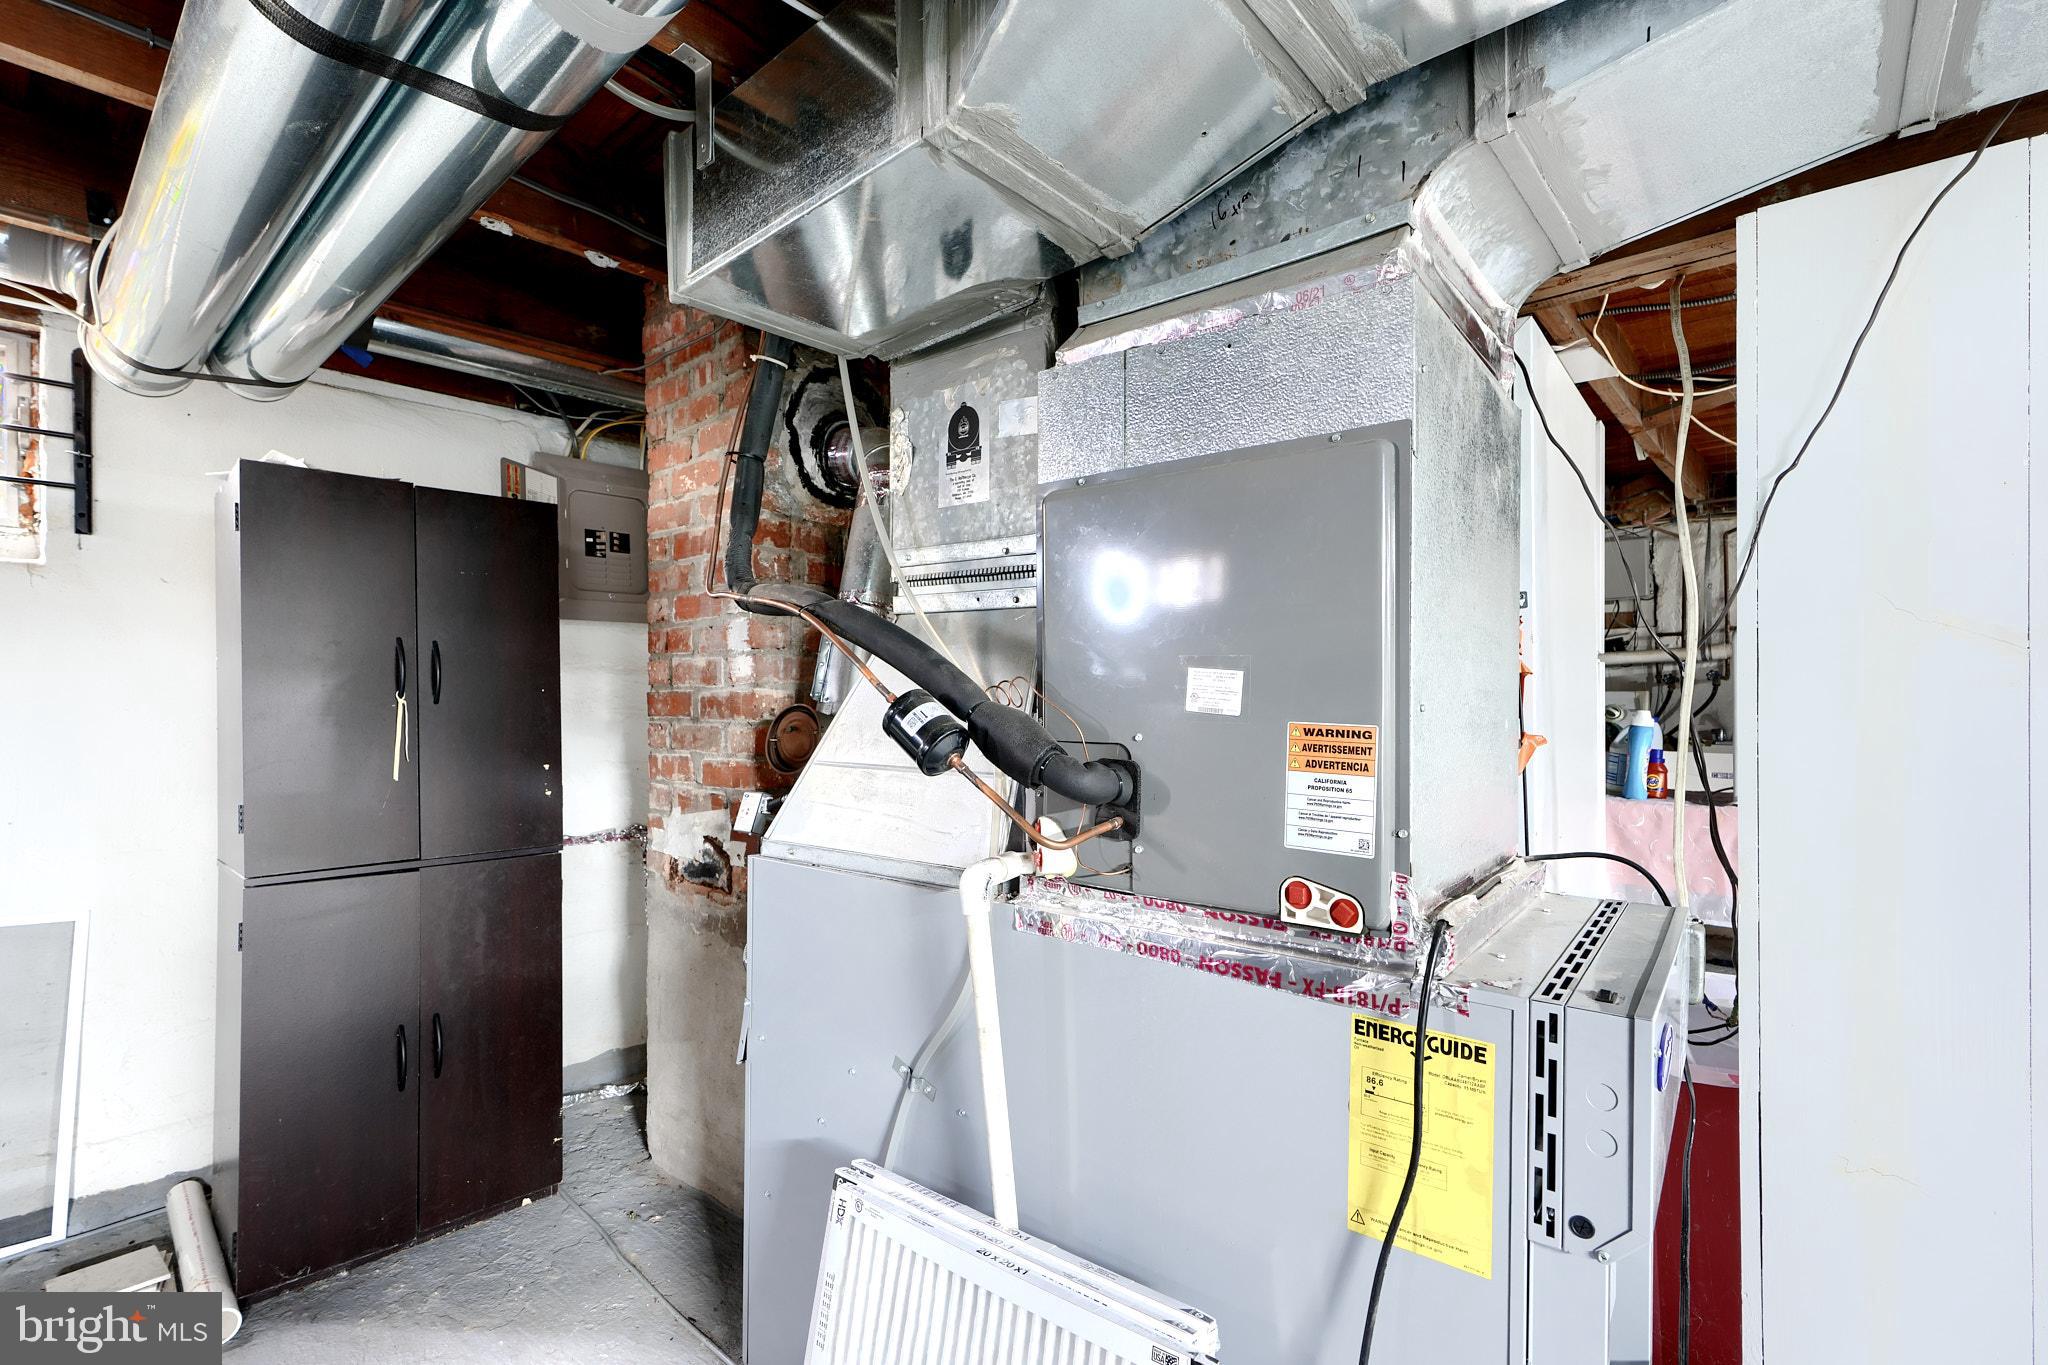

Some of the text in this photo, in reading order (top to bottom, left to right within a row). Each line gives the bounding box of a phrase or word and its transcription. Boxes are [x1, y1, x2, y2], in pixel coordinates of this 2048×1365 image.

[1295, 285, 1325, 304] 06/21
[1303, 728, 1373, 740] WARNING
[1301, 743, 1373, 756] AVERTISSEMENT
[1305, 759, 1369, 773] ADVERTENCIA
[1313, 777, 1347, 786] CALIFORNIA
[1307, 784, 1345, 793] PROPOSITION
[1136, 941, 1182, 964] 0800
[1198, 955, 1282, 989] FASSON
[1366, 1076, 1384, 1086] 86.6
[836, 1198, 847, 1229] HDX
[1153, 1352, 1164, 1364] USA
